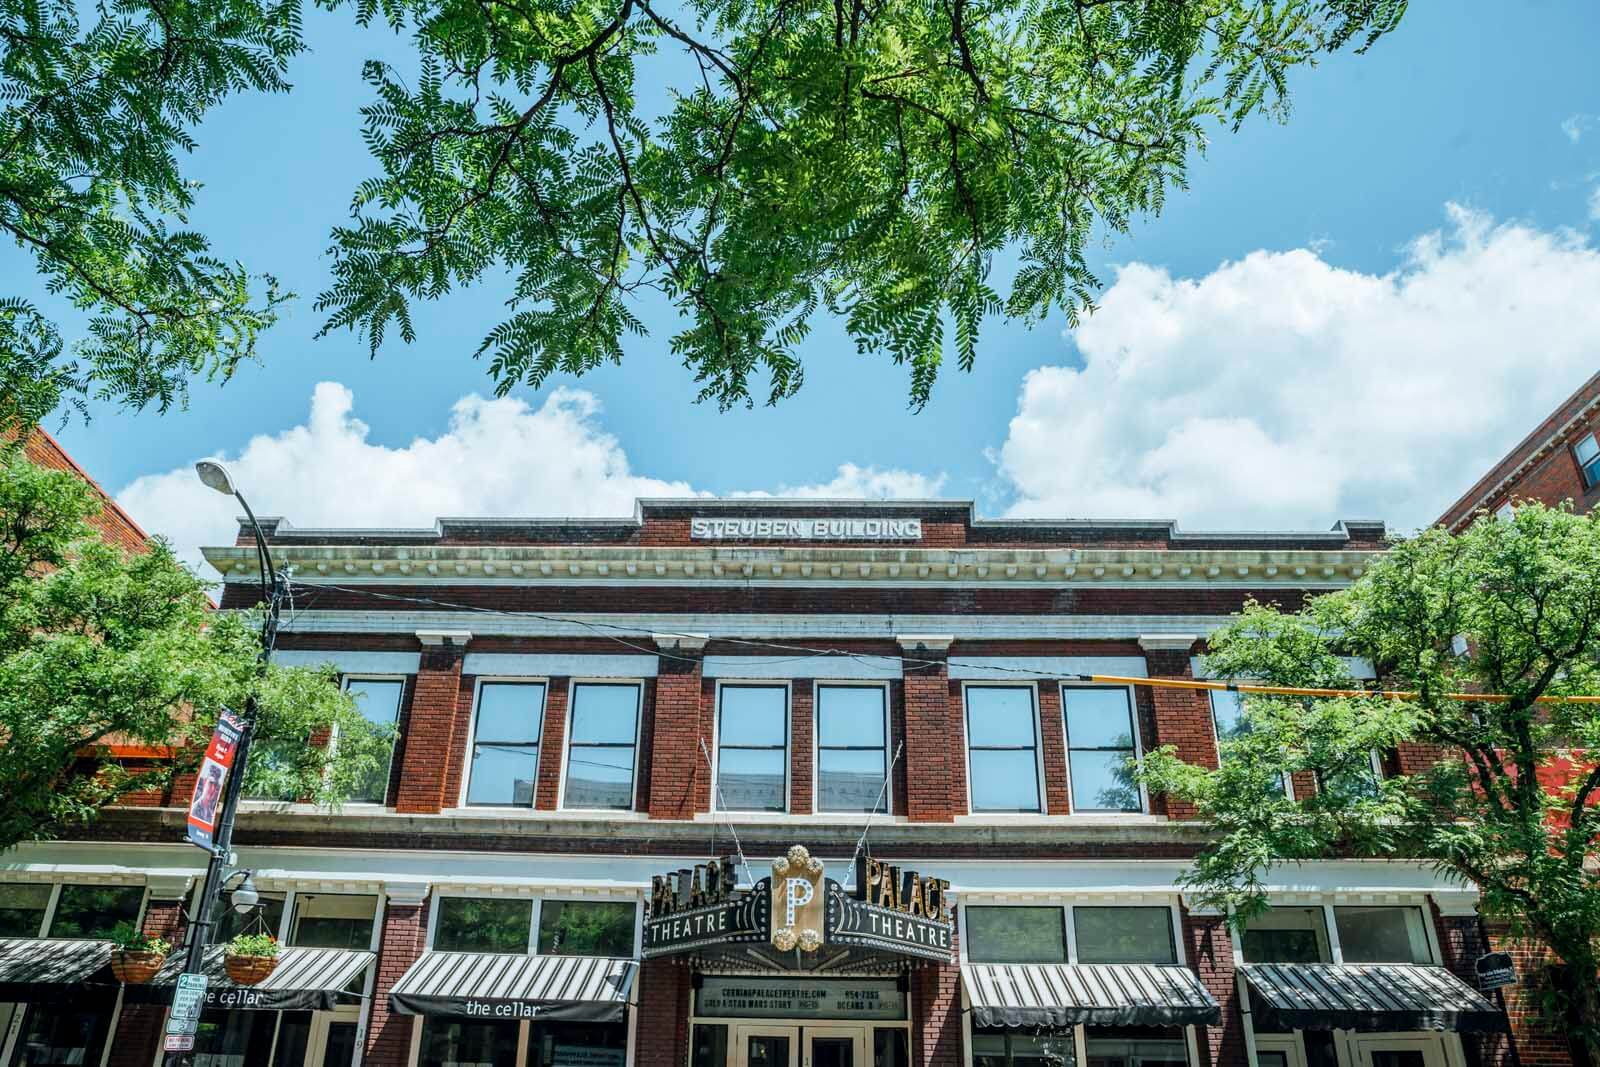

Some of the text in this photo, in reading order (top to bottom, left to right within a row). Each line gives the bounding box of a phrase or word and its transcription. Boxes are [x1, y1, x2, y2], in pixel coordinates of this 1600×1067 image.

[692, 519, 919, 537] STEUBEN BUILDING
[785, 877, 814, 928] P
[865, 856, 950, 925] PALACE
[652, 911, 727, 942] THEATRE
[868, 913, 948, 948] THEATRE
[219, 989, 264, 1005] cellar
[466, 1000, 541, 1017] the cellar
[728, 999, 747, 1009] STAR
[748, 999, 769, 1009] WARS
[770, 1000, 793, 1009] STORY
